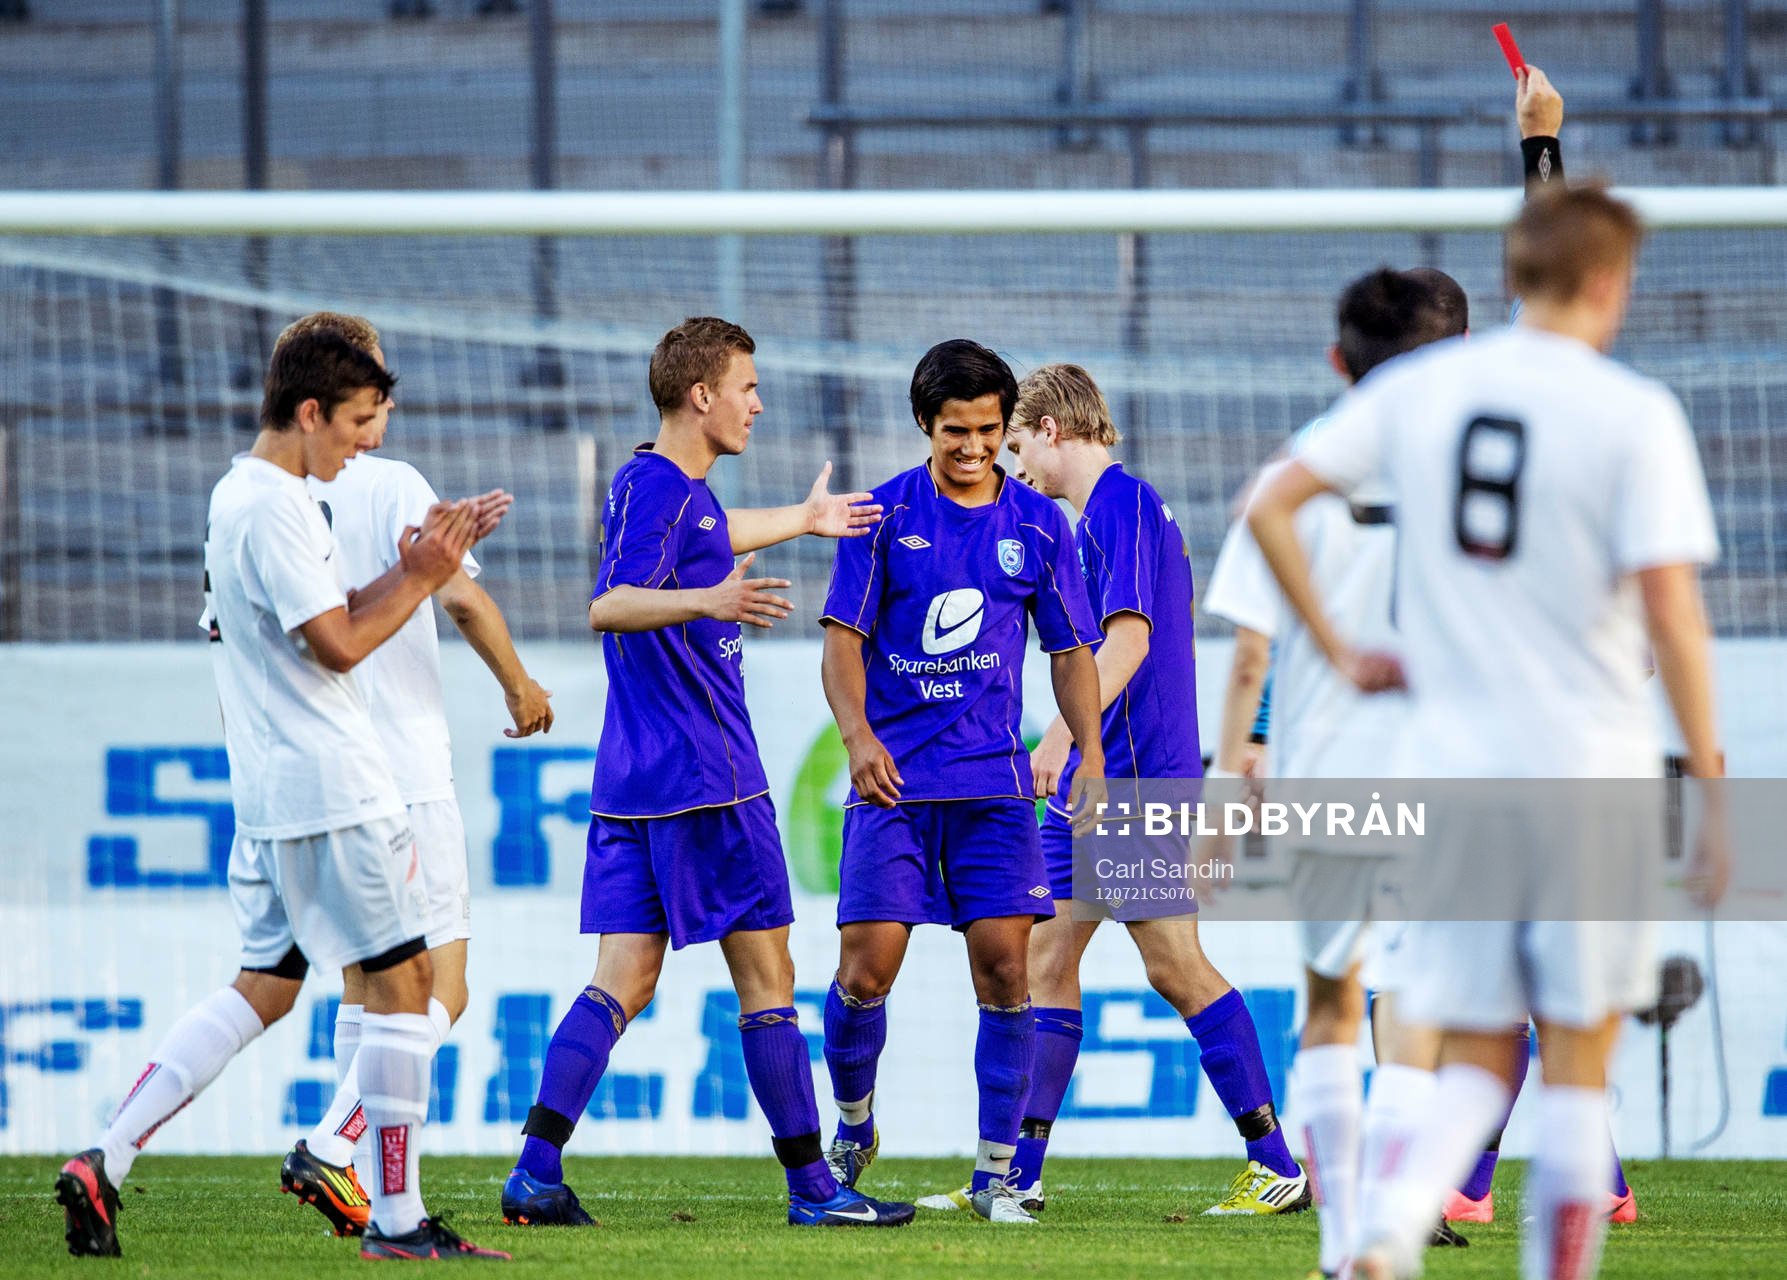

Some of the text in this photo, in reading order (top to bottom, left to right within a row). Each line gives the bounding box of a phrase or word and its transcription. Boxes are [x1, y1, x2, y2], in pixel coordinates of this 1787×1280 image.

[1454, 415, 1529, 562] 8
[888, 650, 1000, 676] Sparebanken
[920, 680, 964, 700] Vest
